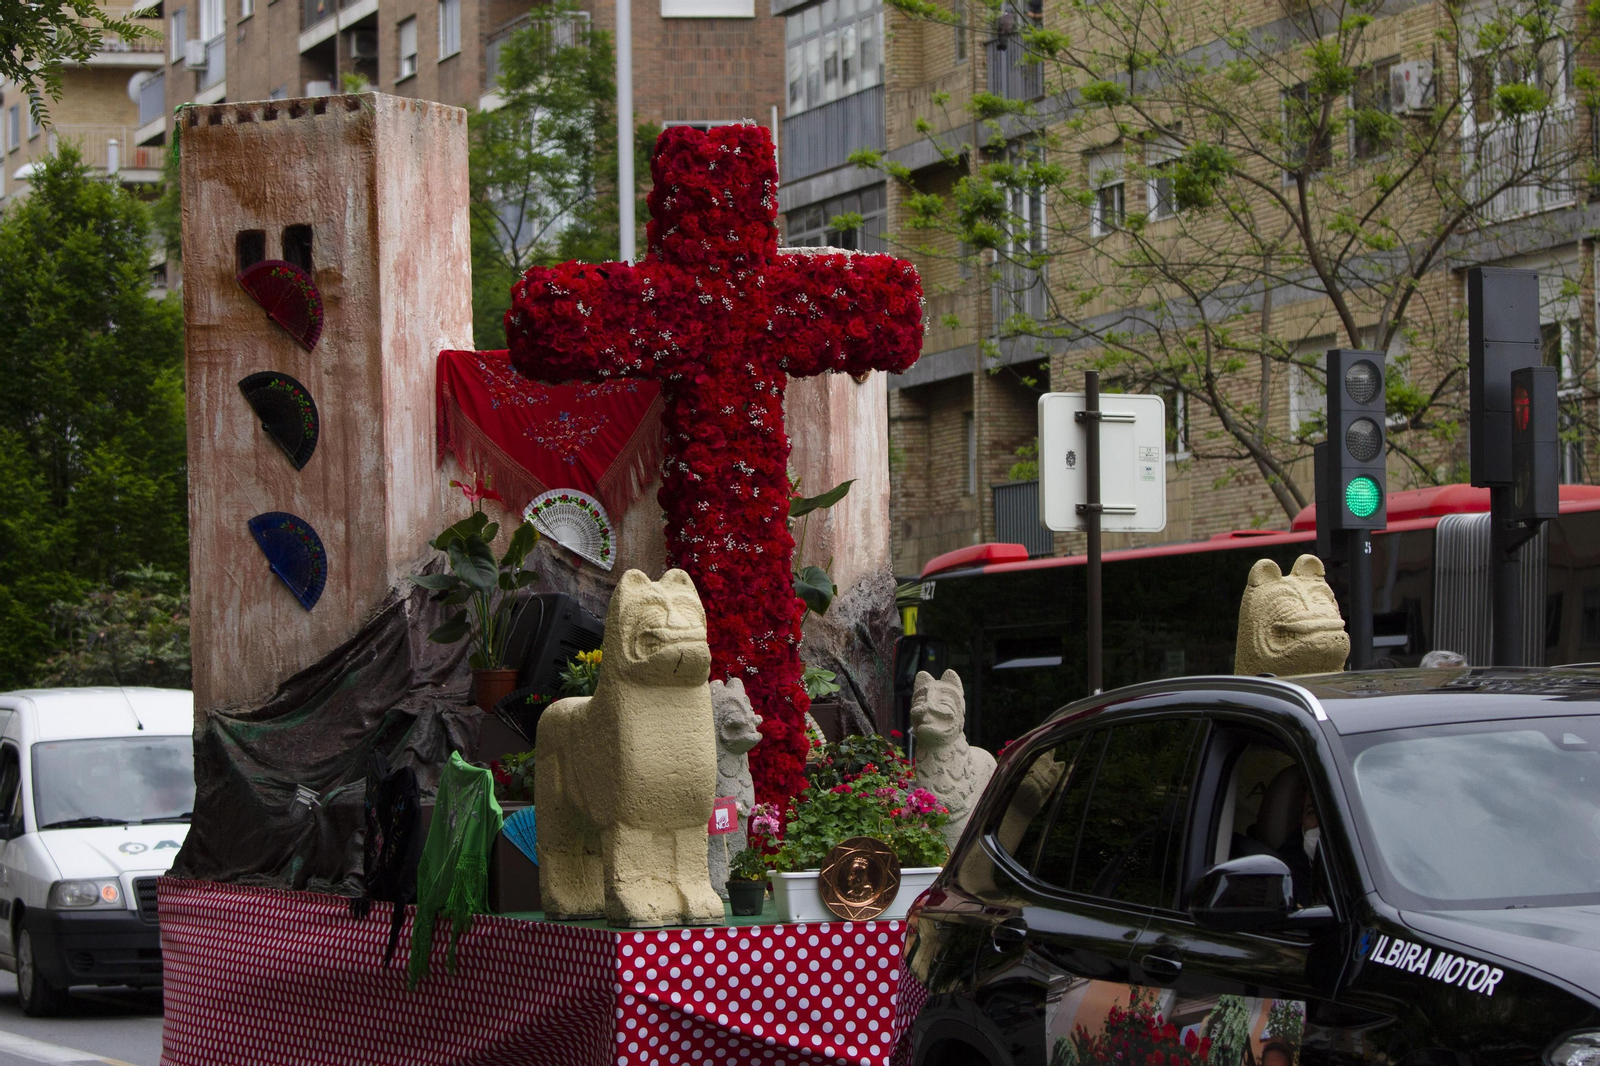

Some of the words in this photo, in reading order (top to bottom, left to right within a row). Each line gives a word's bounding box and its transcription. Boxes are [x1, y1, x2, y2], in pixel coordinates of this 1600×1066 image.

[1364, 541, 1372, 554] 5
[1369, 934, 1432, 976] ILBIRA
[1428, 951, 1504, 996] MOTOR
